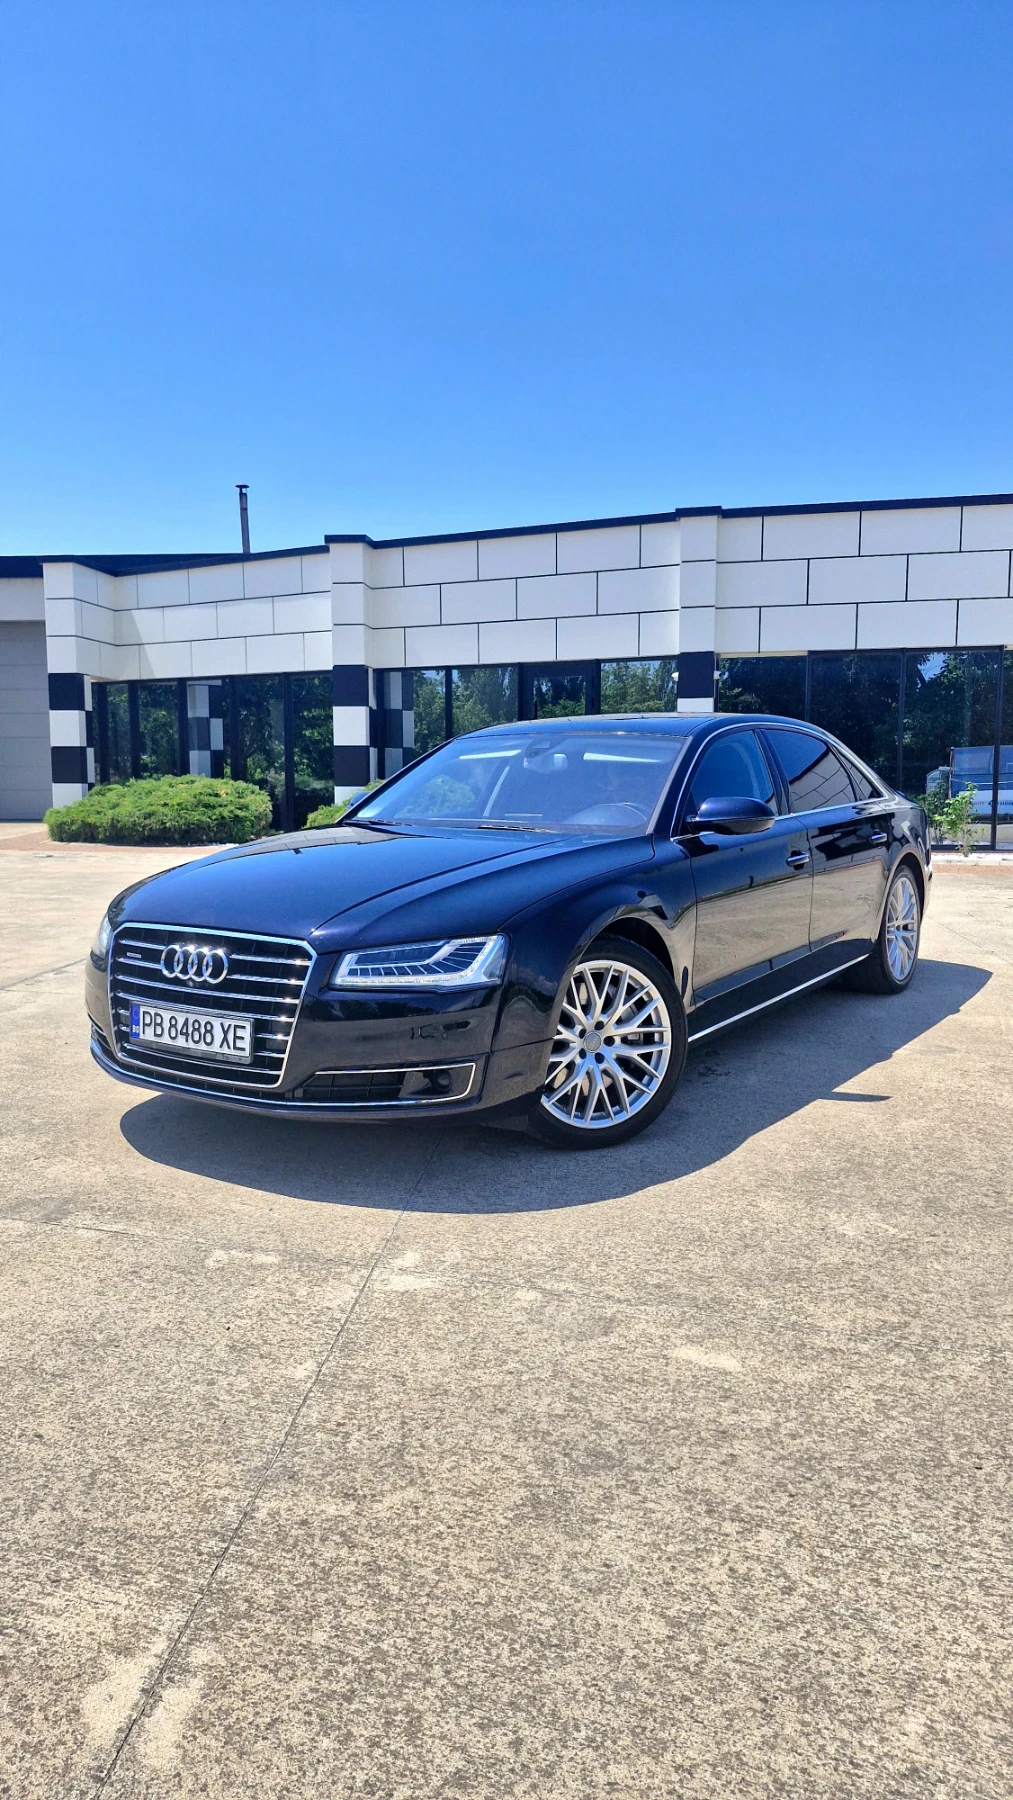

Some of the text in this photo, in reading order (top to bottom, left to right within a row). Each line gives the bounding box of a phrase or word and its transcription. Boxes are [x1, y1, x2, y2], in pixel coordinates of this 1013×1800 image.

[142, 1010, 246, 1051] PB 8488 XE
